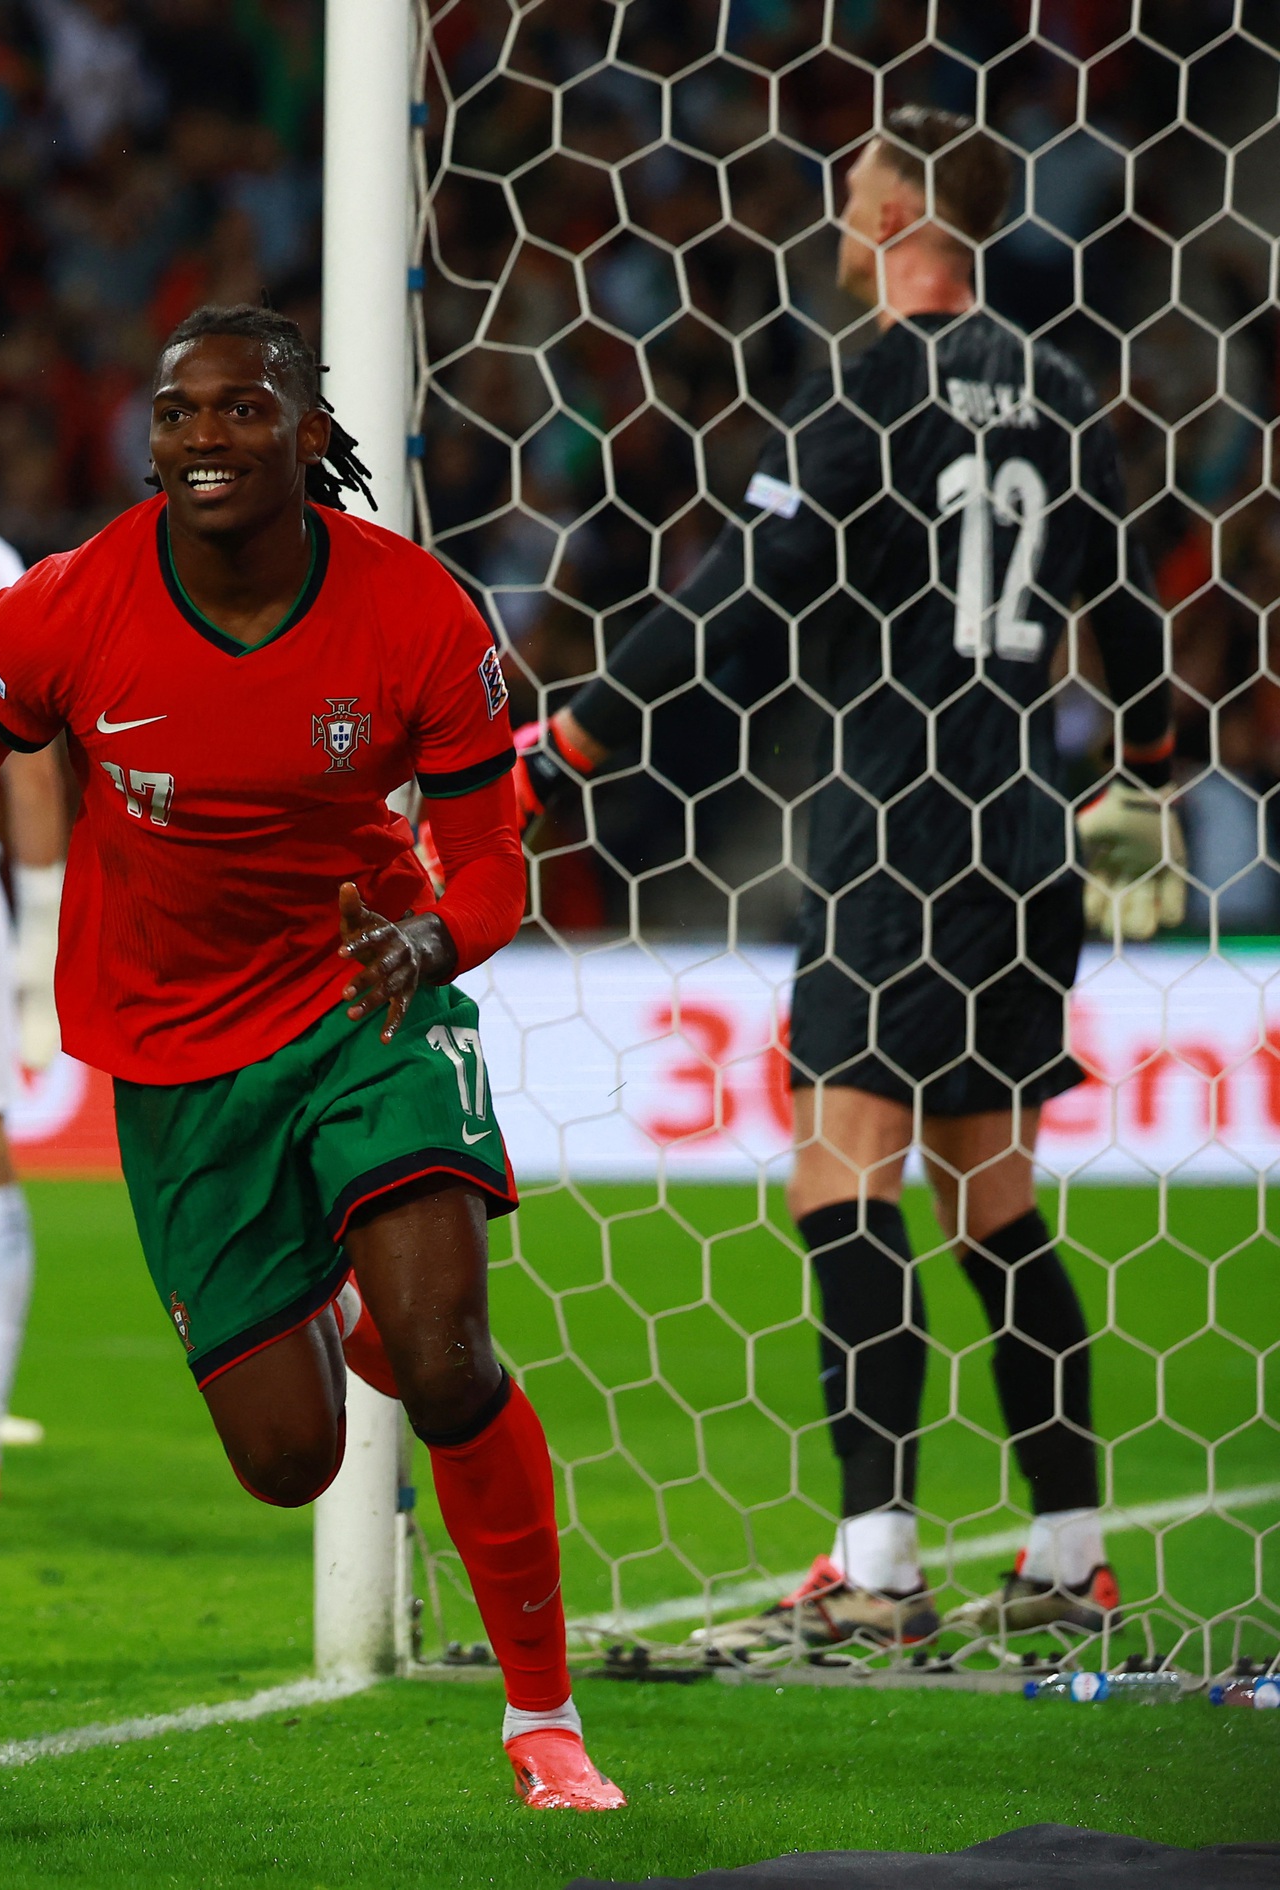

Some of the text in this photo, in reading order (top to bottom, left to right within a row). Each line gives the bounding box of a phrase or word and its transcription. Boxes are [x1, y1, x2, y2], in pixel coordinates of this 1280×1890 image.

[937, 454, 1047, 662] 12
[100, 762, 174, 826] 17
[426, 1025, 486, 1121] 17
